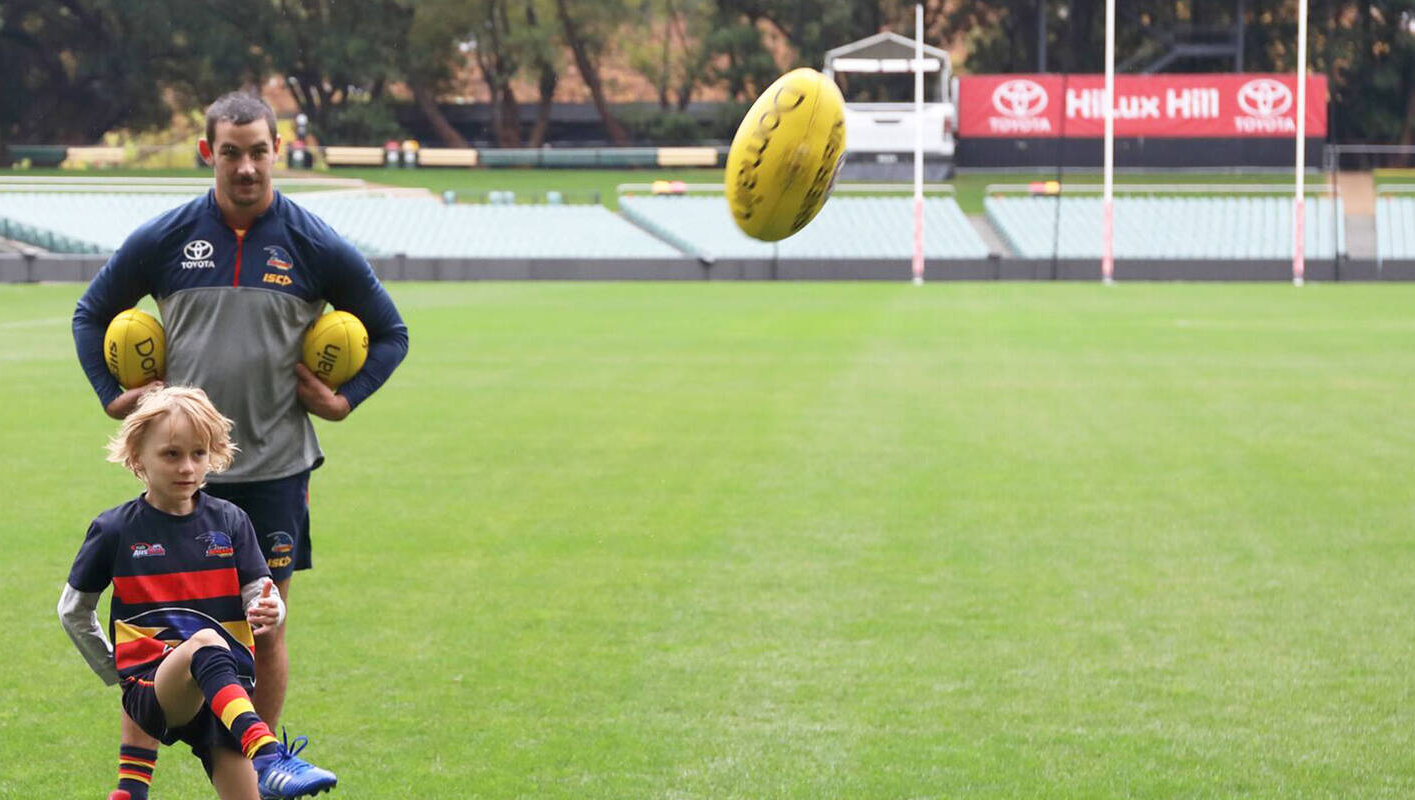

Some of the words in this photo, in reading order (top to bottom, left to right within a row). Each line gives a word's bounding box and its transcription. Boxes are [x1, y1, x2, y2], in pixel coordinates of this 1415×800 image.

[1066, 87, 1160, 118] HiLux
[1166, 87, 1220, 118] Hill
[989, 116, 1051, 133] TOYOTA
[1234, 115, 1296, 133] TOYOTA
[181, 260, 215, 270] TOYOTA
[263, 273, 287, 285] ISC
